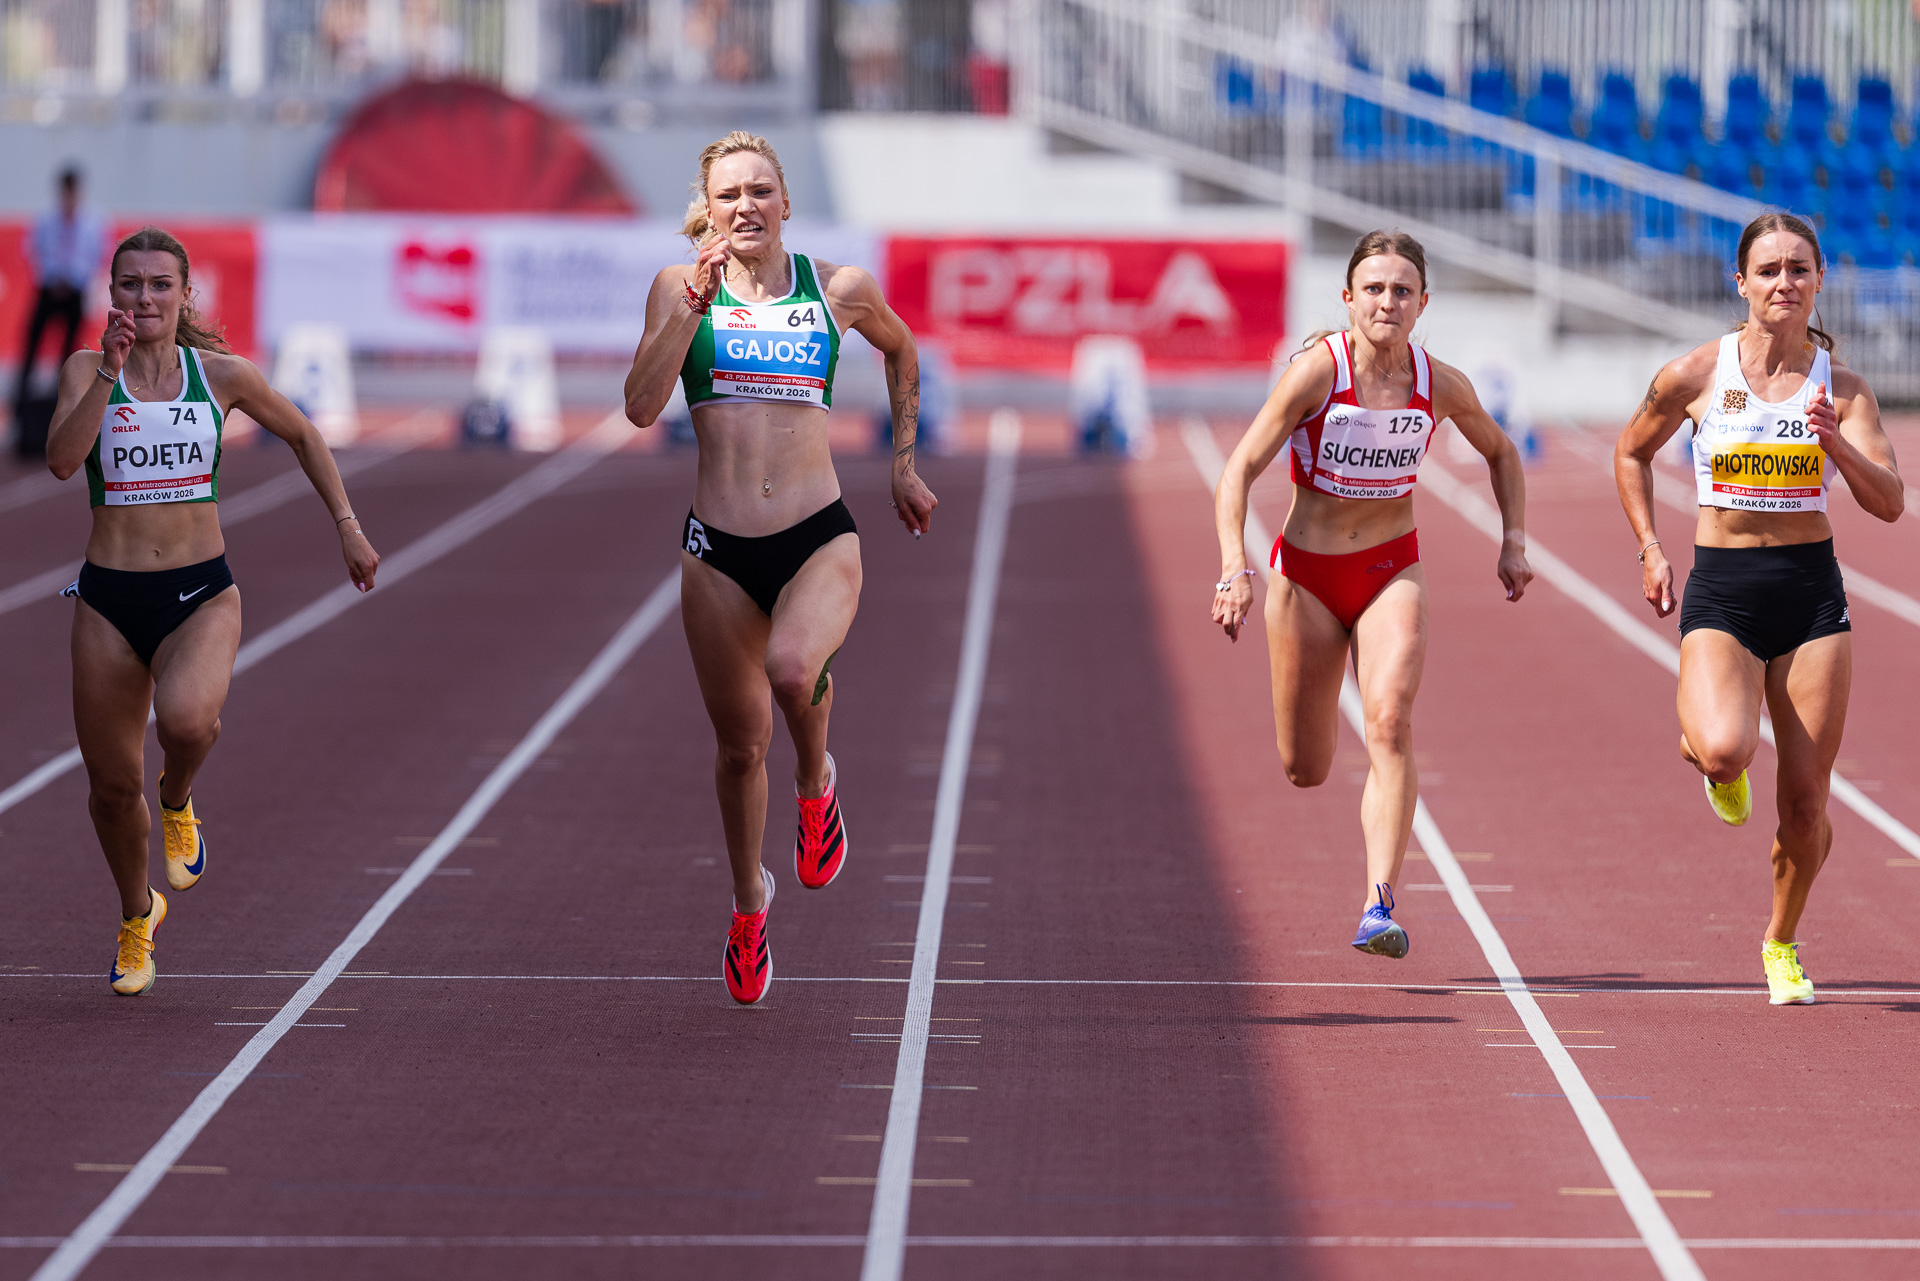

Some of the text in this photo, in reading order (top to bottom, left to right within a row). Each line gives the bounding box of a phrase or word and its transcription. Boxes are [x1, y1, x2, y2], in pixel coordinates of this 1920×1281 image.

[930, 248, 1234, 336] PZLA
[787, 307, 816, 327] 64
[726, 338, 822, 366] GAJOSZ
[735, 374, 751, 382] PZLA
[752, 375, 792, 384] Mistrzostwa
[792, 378, 810, 386] Polski
[735, 384, 811, 398] KRAKÓW 2026
[168, 407, 197, 426] 74
[111, 424, 141, 434] ORLEN
[1354, 420, 1377, 429] Okęcie
[1388, 416, 1423, 434] 175
[1730, 422, 1765, 433] Kraków
[112, 441, 204, 470] POJĘTA
[1322, 441, 1421, 468] SUCHENEK
[1714, 453, 1820, 477] PIOTROWSKA
[122, 482, 138, 490] PZLA
[138, 479, 178, 489] Mistrzostwa
[178, 477, 193, 486] Polski
[193, 476, 204, 484] U23
[1333, 475, 1348, 485] PZLA
[1348, 479, 1384, 487] Mistrzostwa
[1384, 478, 1399, 487] Polski
[124, 488, 194, 503] KRAKÓW 2026
[1332, 485, 1398, 497] KRAKÓW 2026
[1731, 487, 1746, 496] PZLA
[1746, 488, 1784, 497] Mistrzostwa
[1784, 490, 1801, 498] Polski
[1731, 498, 1802, 509] KRAKÓW 2026
[688, 526, 703, 555] 5
